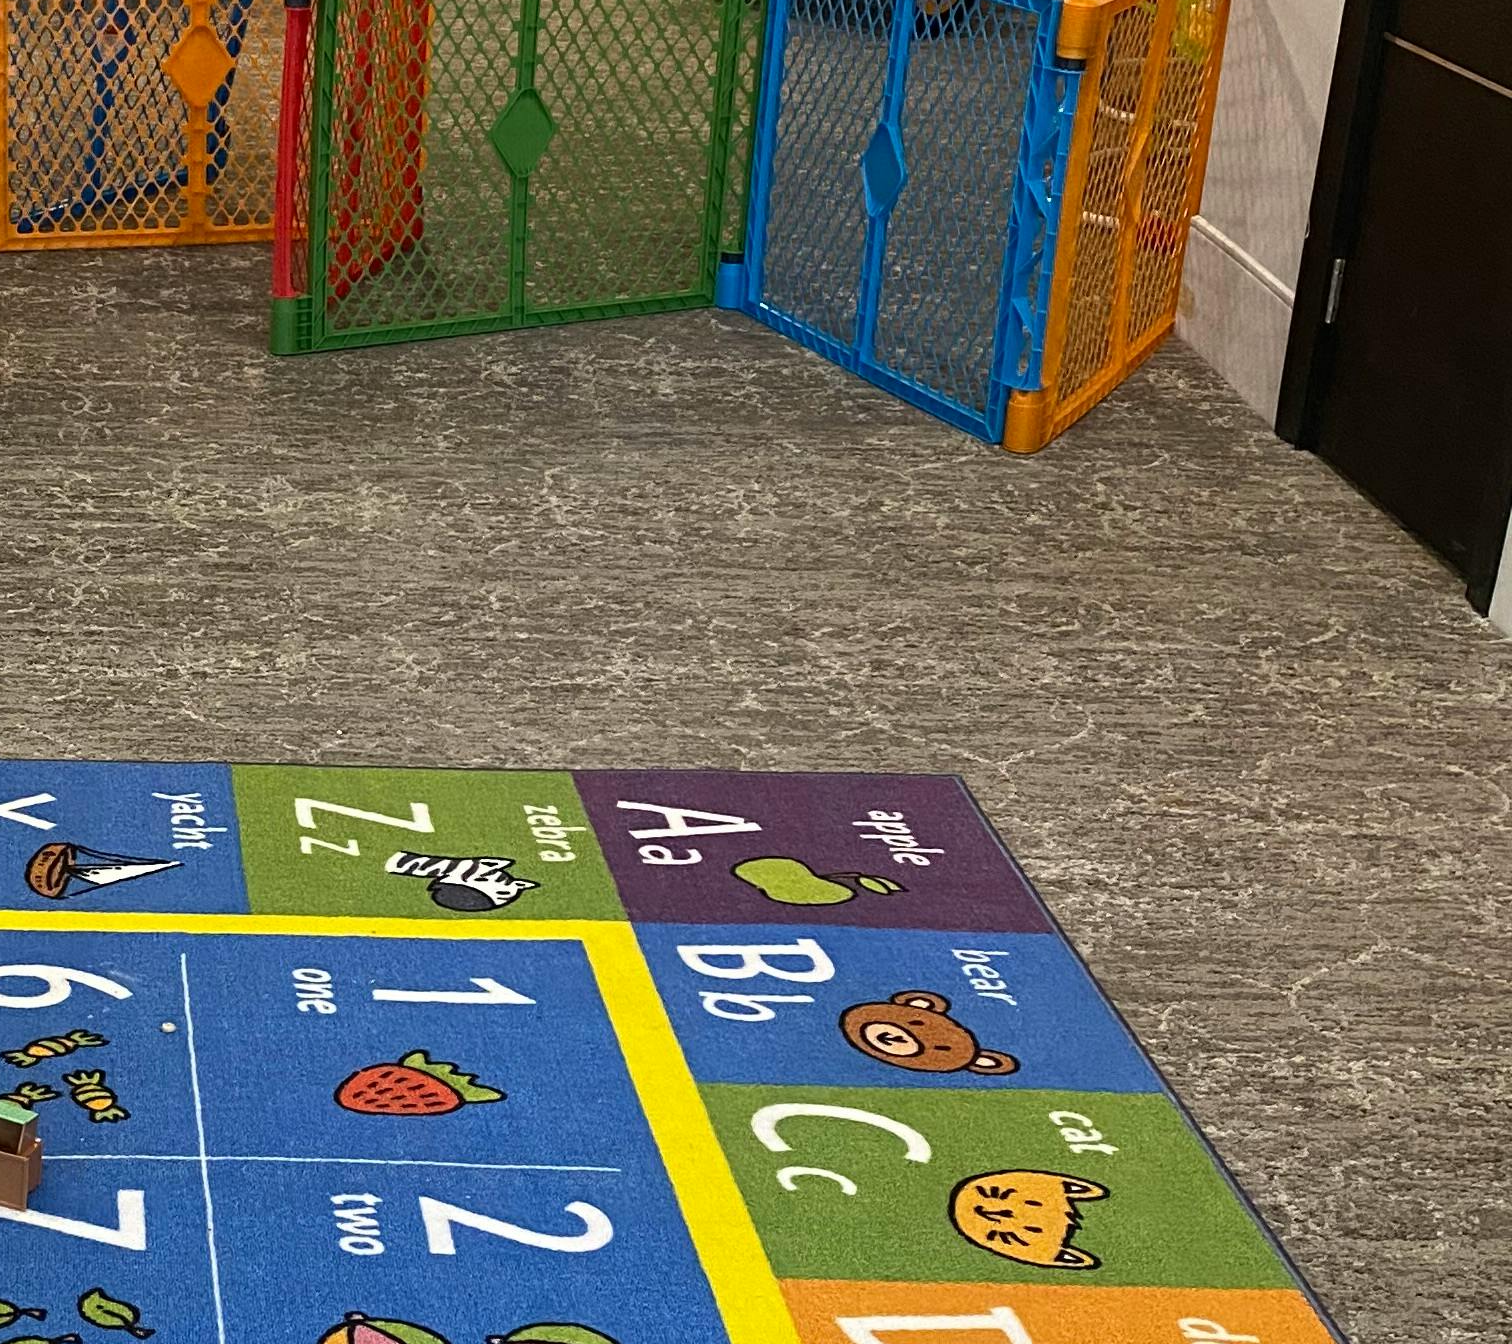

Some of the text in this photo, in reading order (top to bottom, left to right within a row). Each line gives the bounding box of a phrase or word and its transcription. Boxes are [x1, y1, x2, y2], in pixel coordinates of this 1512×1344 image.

[152, 793, 227, 849] yacht
[524, 805, 577, 861] zebra
[853, 811, 944, 865] apple
[292, 969, 336, 1013] one
[373, 978, 536, 1004] 1
[952, 950, 1017, 1005] bear
[1049, 1111, 1118, 1154] cat
[331, 1193, 384, 1255] two
[419, 1197, 613, 1254] 2
